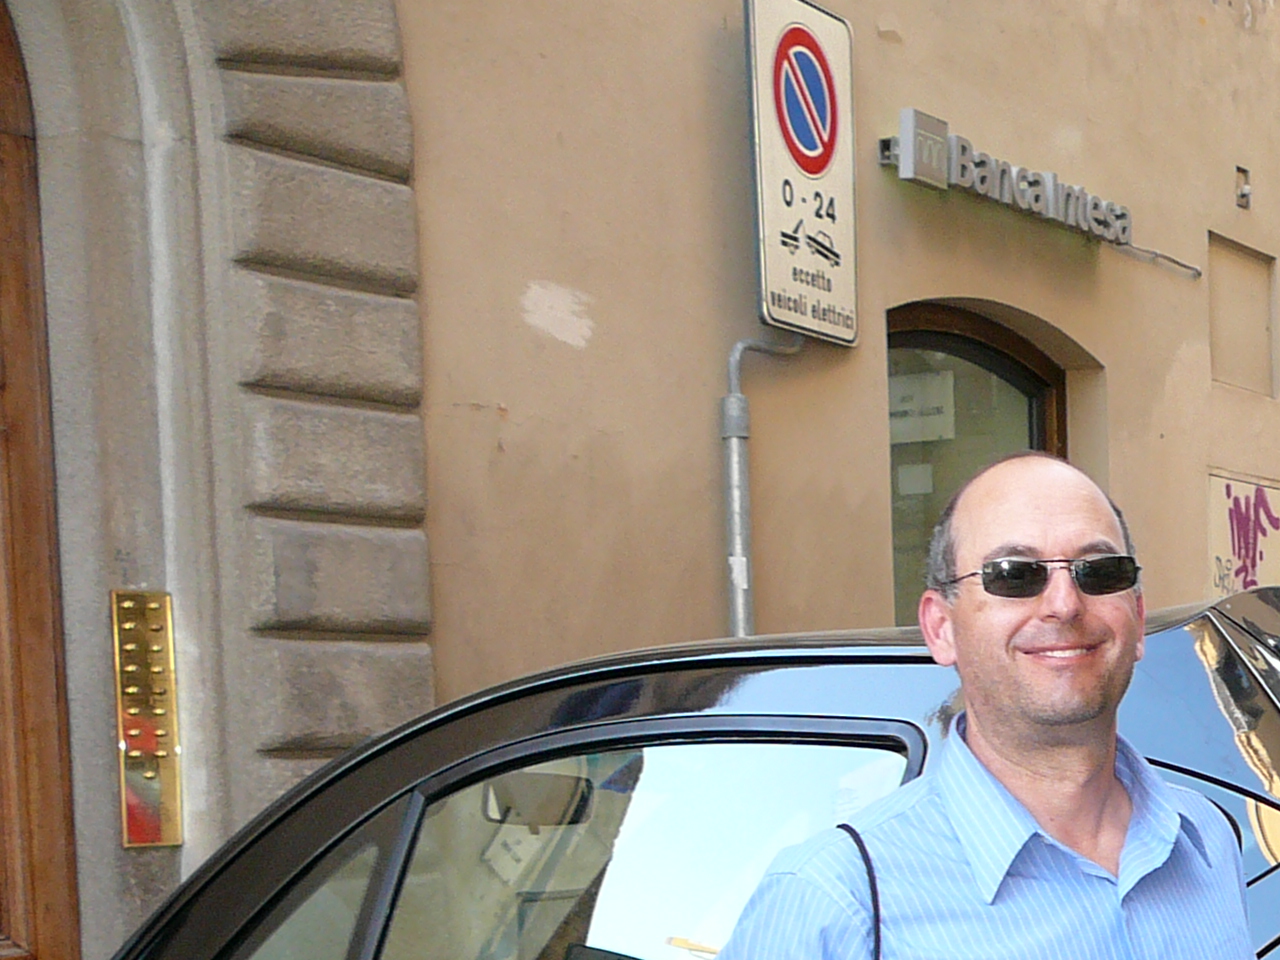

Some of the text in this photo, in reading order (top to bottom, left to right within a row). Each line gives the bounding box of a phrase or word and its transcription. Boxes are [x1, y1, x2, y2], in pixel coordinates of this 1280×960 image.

[782, 178, 794, 208] 0
[813, 190, 837, 225] 24
[949, 134, 1133, 246] BancaIntesa
[792, 266, 833, 293] eccetto
[770, 287, 855, 331] veicoli elettrici
